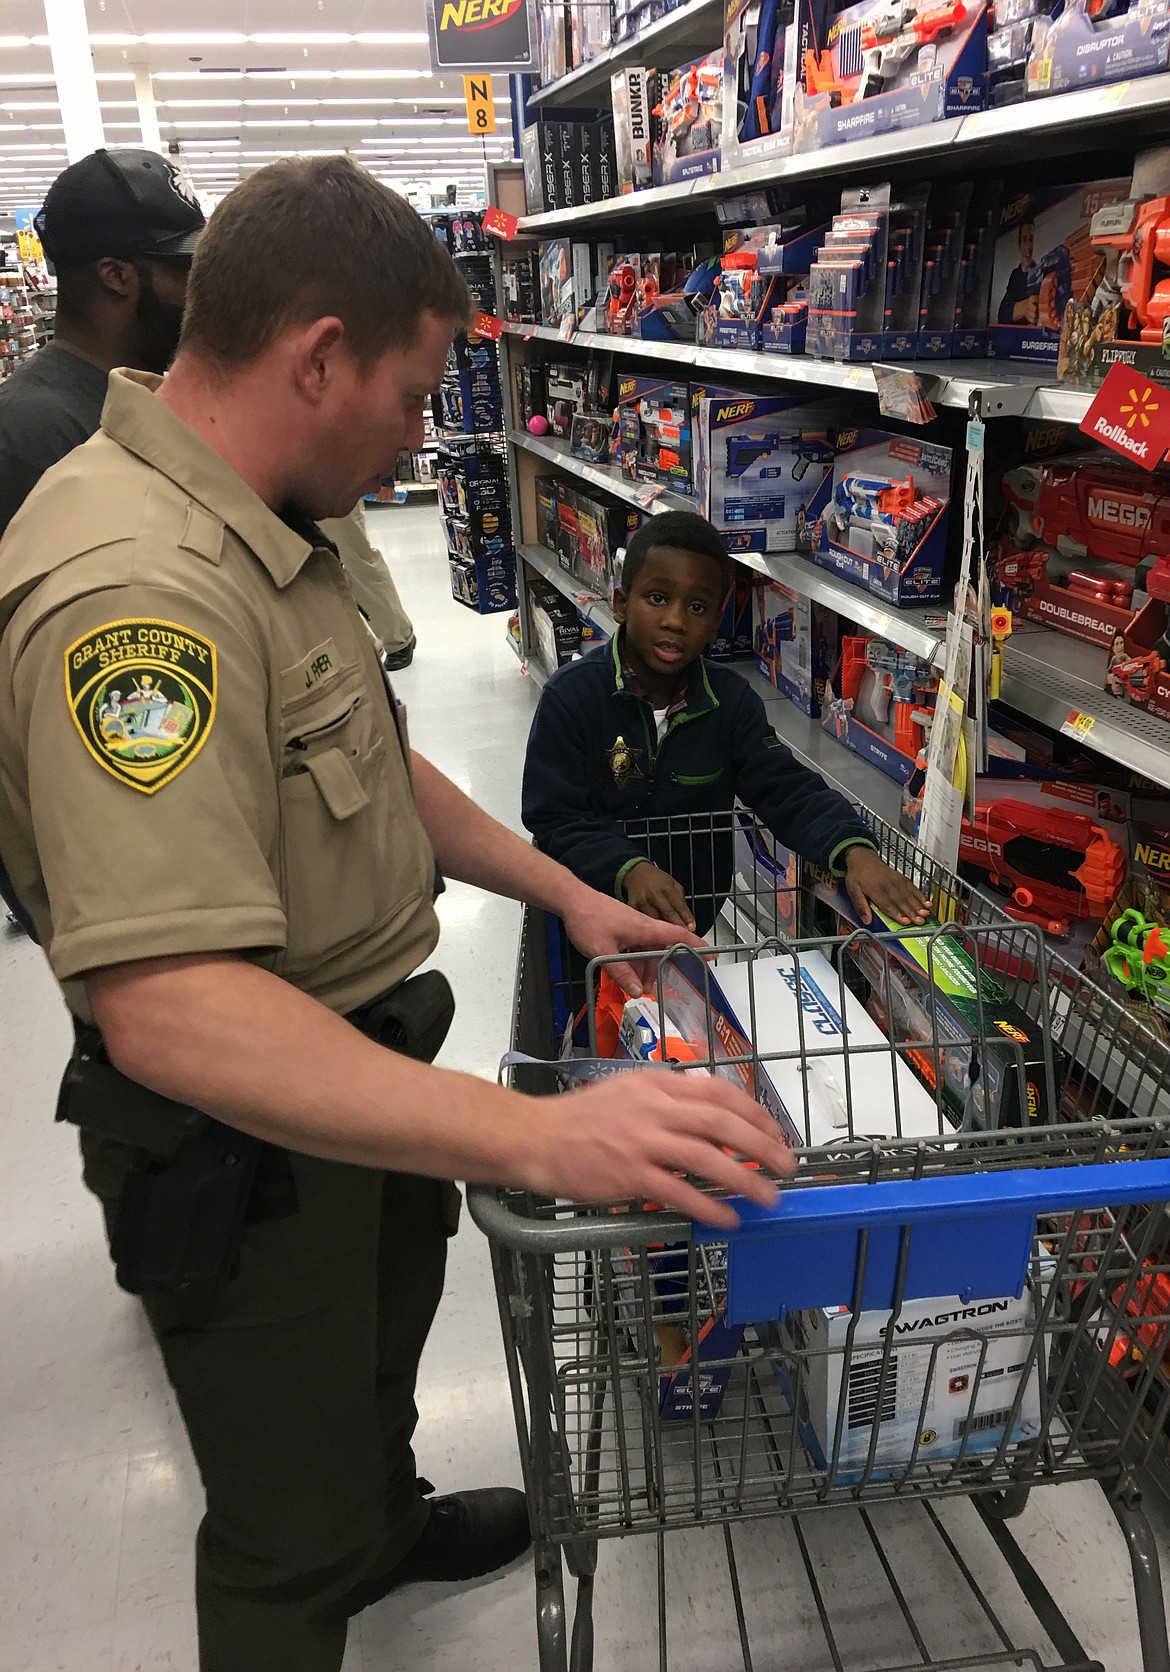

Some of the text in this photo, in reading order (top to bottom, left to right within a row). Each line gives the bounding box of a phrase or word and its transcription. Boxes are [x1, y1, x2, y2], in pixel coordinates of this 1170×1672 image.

[440, 0, 518, 30] NERF
[1077, 35, 1125, 56] DISRUPTOR
[911, 69, 942, 86] ELITE
[470, 80, 488, 101] N
[628, 73, 644, 139] BUNKR
[476, 109, 488, 128] 8
[837, 112, 875, 131] SHARPFIRE
[544, 152, 553, 162] X
[562, 160, 571, 169] X
[600, 153, 608, 163] X
[580, 153, 591, 204] ASER X
[1021, 340, 1058, 352] SURGEFIRE
[619, 379, 637, 395] NERF
[716, 402, 755, 421] NERF
[836, 430, 859, 448] NERF
[1093, 416, 1149, 459] Rollback
[1087, 497, 1151, 529] MEGA
[877, 555, 899, 571] ELITE
[559, 625, 580, 634] RIVAL
[73, 628, 209, 669] GRANT COUNTY
[99, 644, 181, 668] SHERIFF
[960, 833, 1002, 857] EGA
[993, 1020, 1031, 1042] NERF
[1027, 1084, 1038, 1118] NERF
[879, 1300, 1008, 1337] SWAGTRON
